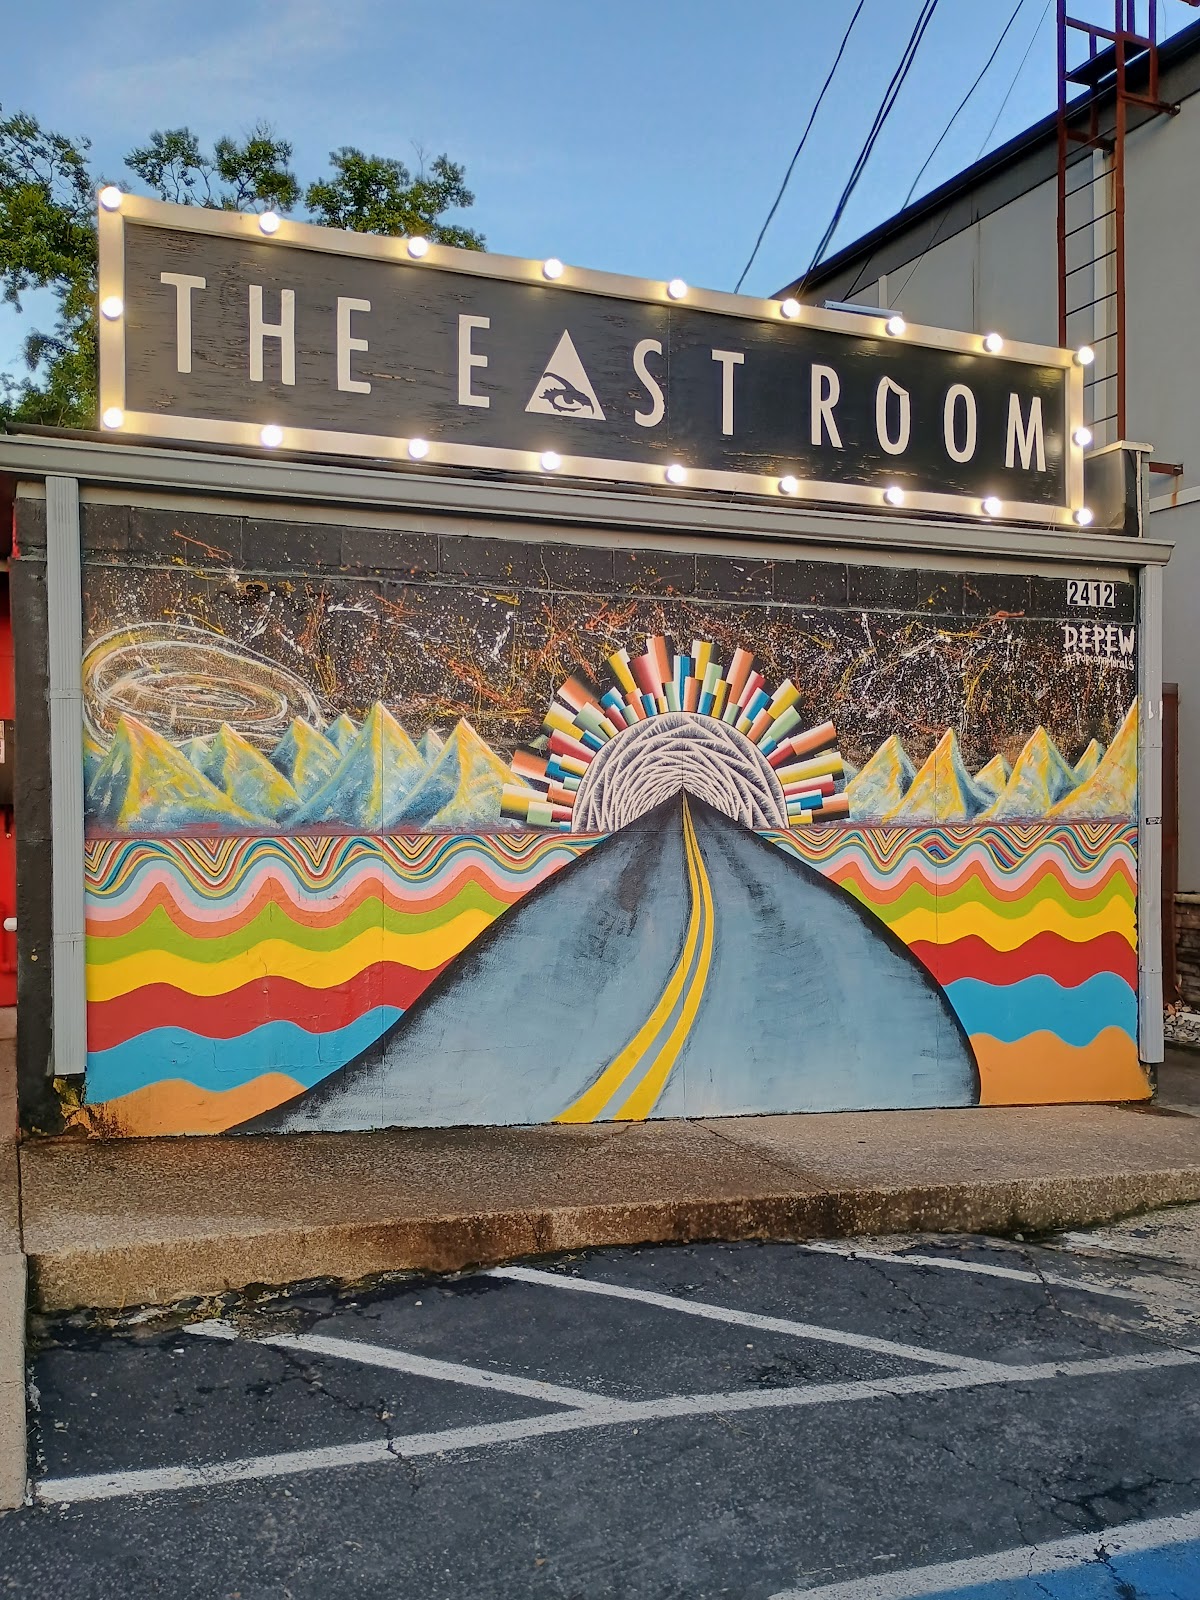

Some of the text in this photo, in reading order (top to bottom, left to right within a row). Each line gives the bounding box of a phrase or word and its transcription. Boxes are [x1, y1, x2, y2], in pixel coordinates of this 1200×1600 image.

[160, 271, 1046, 472] THE EAST ROOM
[1069, 581, 1113, 606] 2412
[1061, 624, 1135, 656] DEPEW
